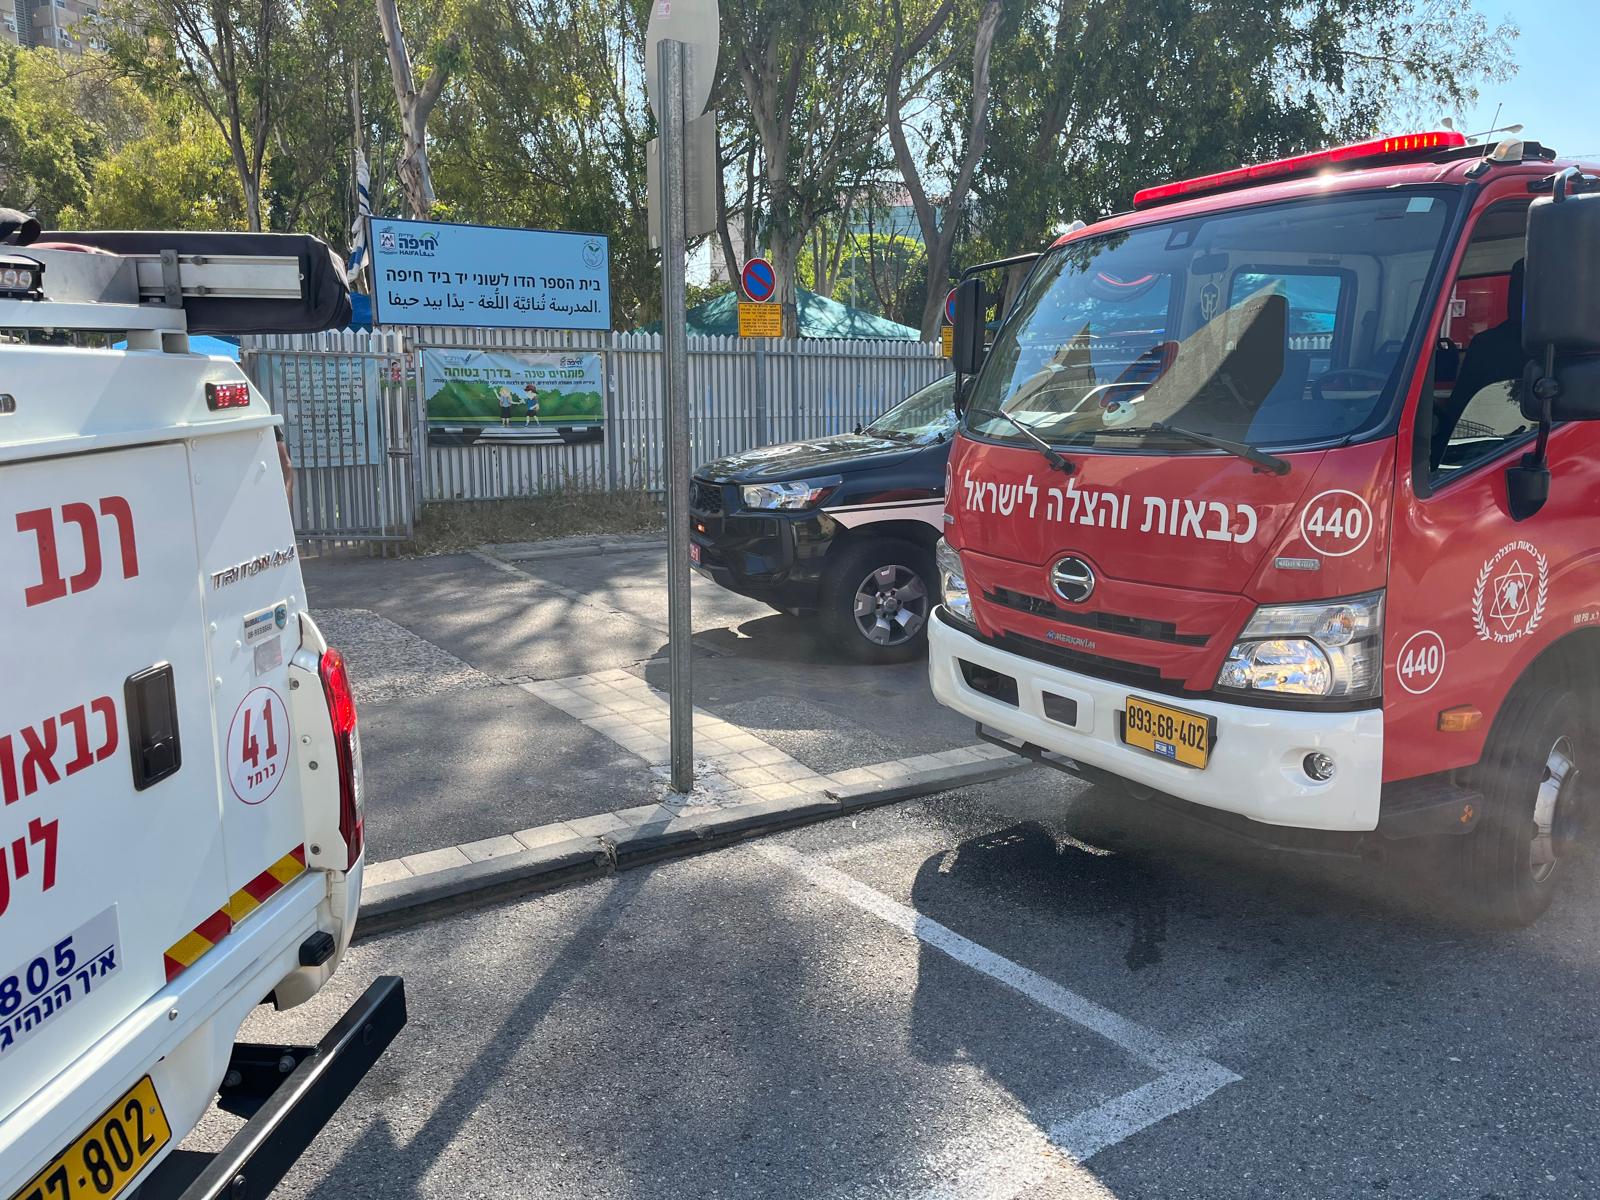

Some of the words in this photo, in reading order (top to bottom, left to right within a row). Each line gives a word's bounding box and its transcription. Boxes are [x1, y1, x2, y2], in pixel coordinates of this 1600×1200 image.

[399, 238, 435, 250] חיפה
[386, 269, 423, 283] חיפה
[428, 271, 452, 284] ביד
[455, 273, 468, 284] יד
[473, 273, 509, 286] לשוני
[513, 275, 536, 288] הדו
[539, 277, 575, 290] הספר
[579, 279, 601, 291] בית
[388, 291, 420, 309] حيفا
[423, 296, 443, 310] بيد
[444, 367, 480, 377] בטוחה
[482, 368, 512, 380] בדרך
[524, 369, 546, 379] שנה
[548, 369, 585, 379] פותחים
[964, 470, 1038, 519] לישראל
[1046, 477, 1131, 530] והצלה
[1140, 496, 1258, 545] כבאות
[1307, 506, 1363, 540] 440
[16, 495, 139, 607] רכב
[1494, 540, 1517, 562] והצלה
[1517, 540, 1538, 557] כבאות
[211, 553, 270, 591] TRITON
[1493, 629, 1522, 643] לישראל
[1402, 645, 1438, 679] 440
[242, 698, 278, 769] 41
[247, 763, 276, 790] כרמל
[76, 949, 117, 995] איך
